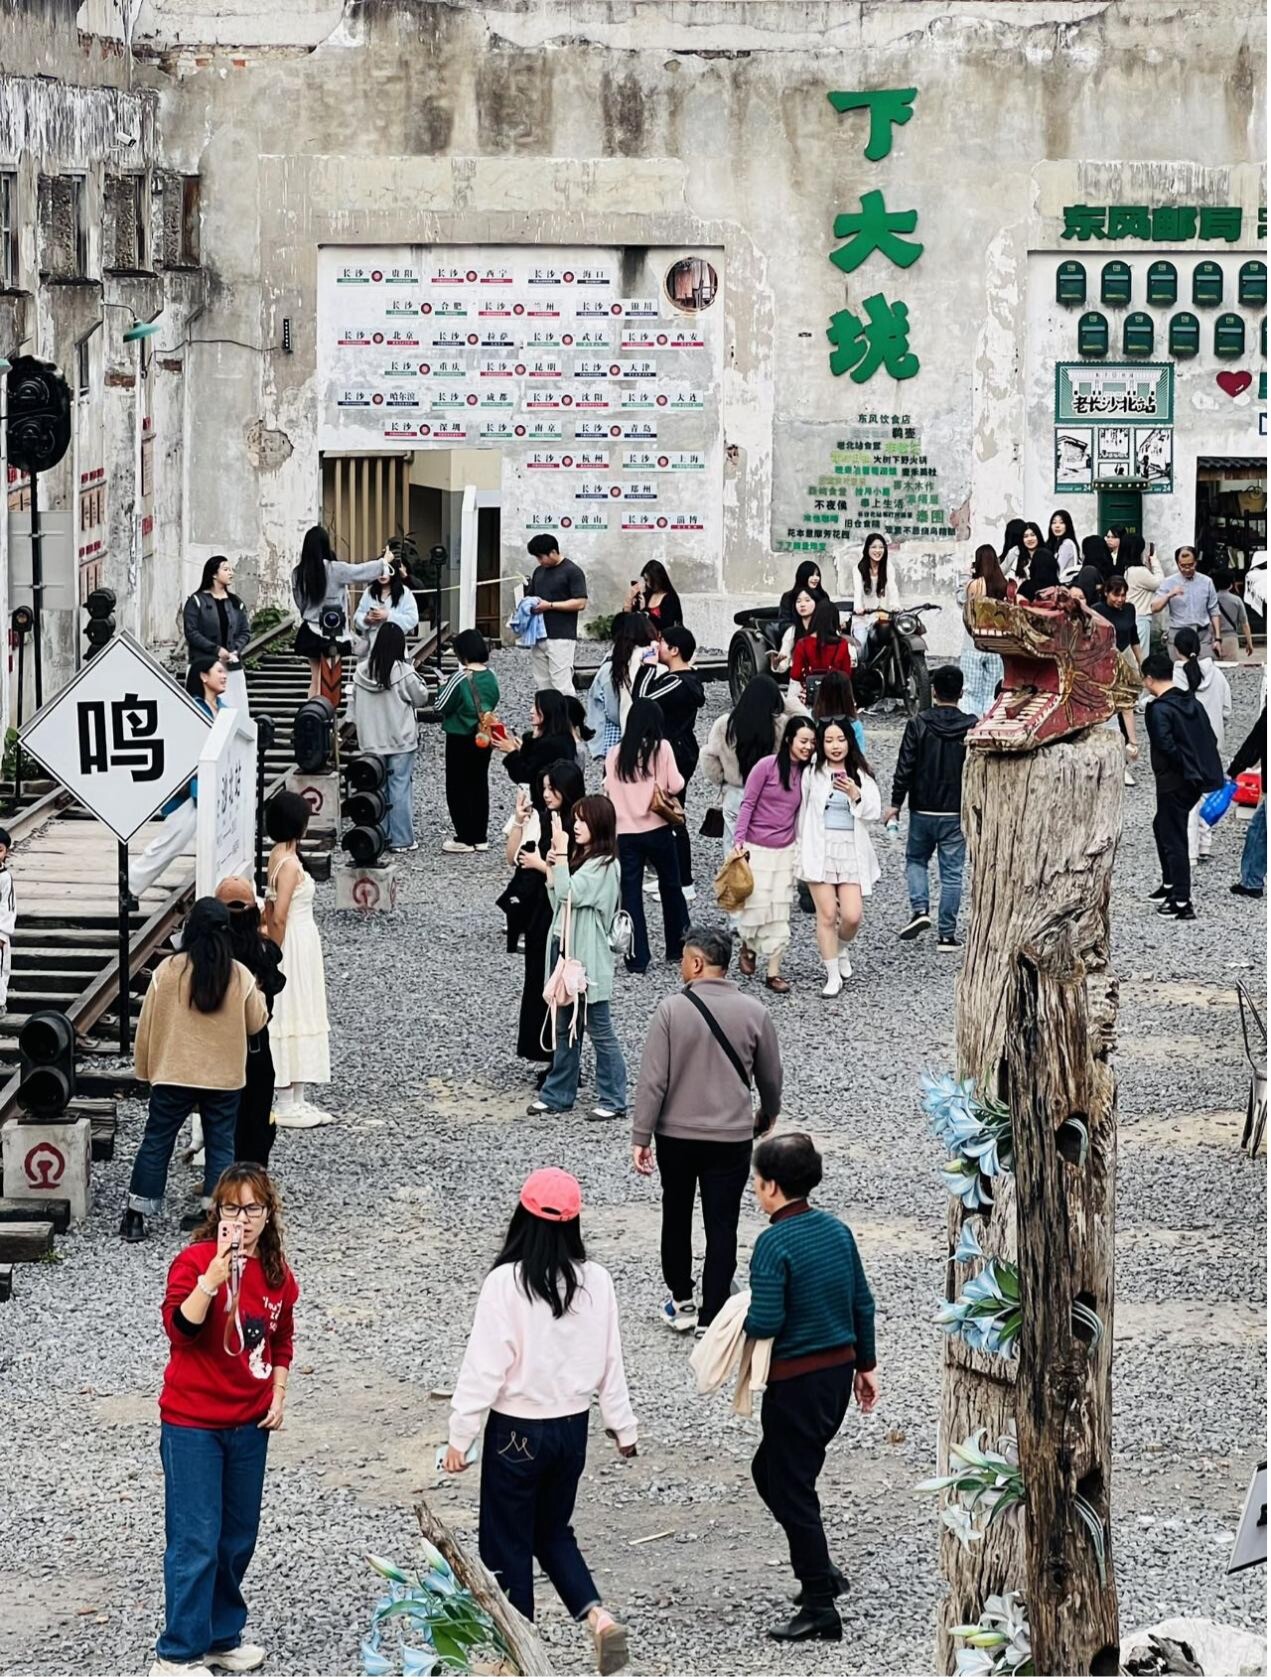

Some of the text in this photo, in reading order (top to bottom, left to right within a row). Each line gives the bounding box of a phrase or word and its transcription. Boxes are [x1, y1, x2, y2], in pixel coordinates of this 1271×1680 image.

[1061, 205, 1243, 242] 东风邮局
[344, 269, 412, 278] 长沙 贵阳
[438, 269, 507, 278] 长沙 西宁
[535, 270, 603, 279] 长沙 海口
[392, 301, 461, 310] 长沙 合肥
[485, 302, 505, 310] 长沙
[584, 302, 604, 311] 长沙
[345, 331, 413, 340] 长沙 北京
[440, 332, 459, 340] 长沙
[534, 332, 602, 341] 长沙 武汉
[629, 333, 697, 341] 长沙 西安
[392, 362, 459, 371] 长沙 重庆
[487, 362, 555, 372] 长沙 昆明
[582, 363, 650, 371] 长沙 天津
[345, 392, 415, 401] 长沙 哈尔滨
[439, 392, 507, 401] 长沙 成都
[534, 393, 602, 402] 长沙 沈阳
[629, 393, 696, 402] 长沙 大连
[1073, 396, 1156, 414] 老长沙北站
[858, 414, 911, 424] 东风饮食店
[392, 422, 460, 431] 长沙 深圳
[487, 423, 555, 432] 长沙 南京
[583, 424, 651, 432] 长沙 青岛
[534, 454, 603, 463] 长沙 杭州
[630, 454, 698, 463] 长沙 上海
[583, 485, 602, 494] 长沙
[533, 515, 601, 524] 长沙 黄山
[629, 515, 648, 523] 长沙
[77, 693, 164, 782] 鸣
